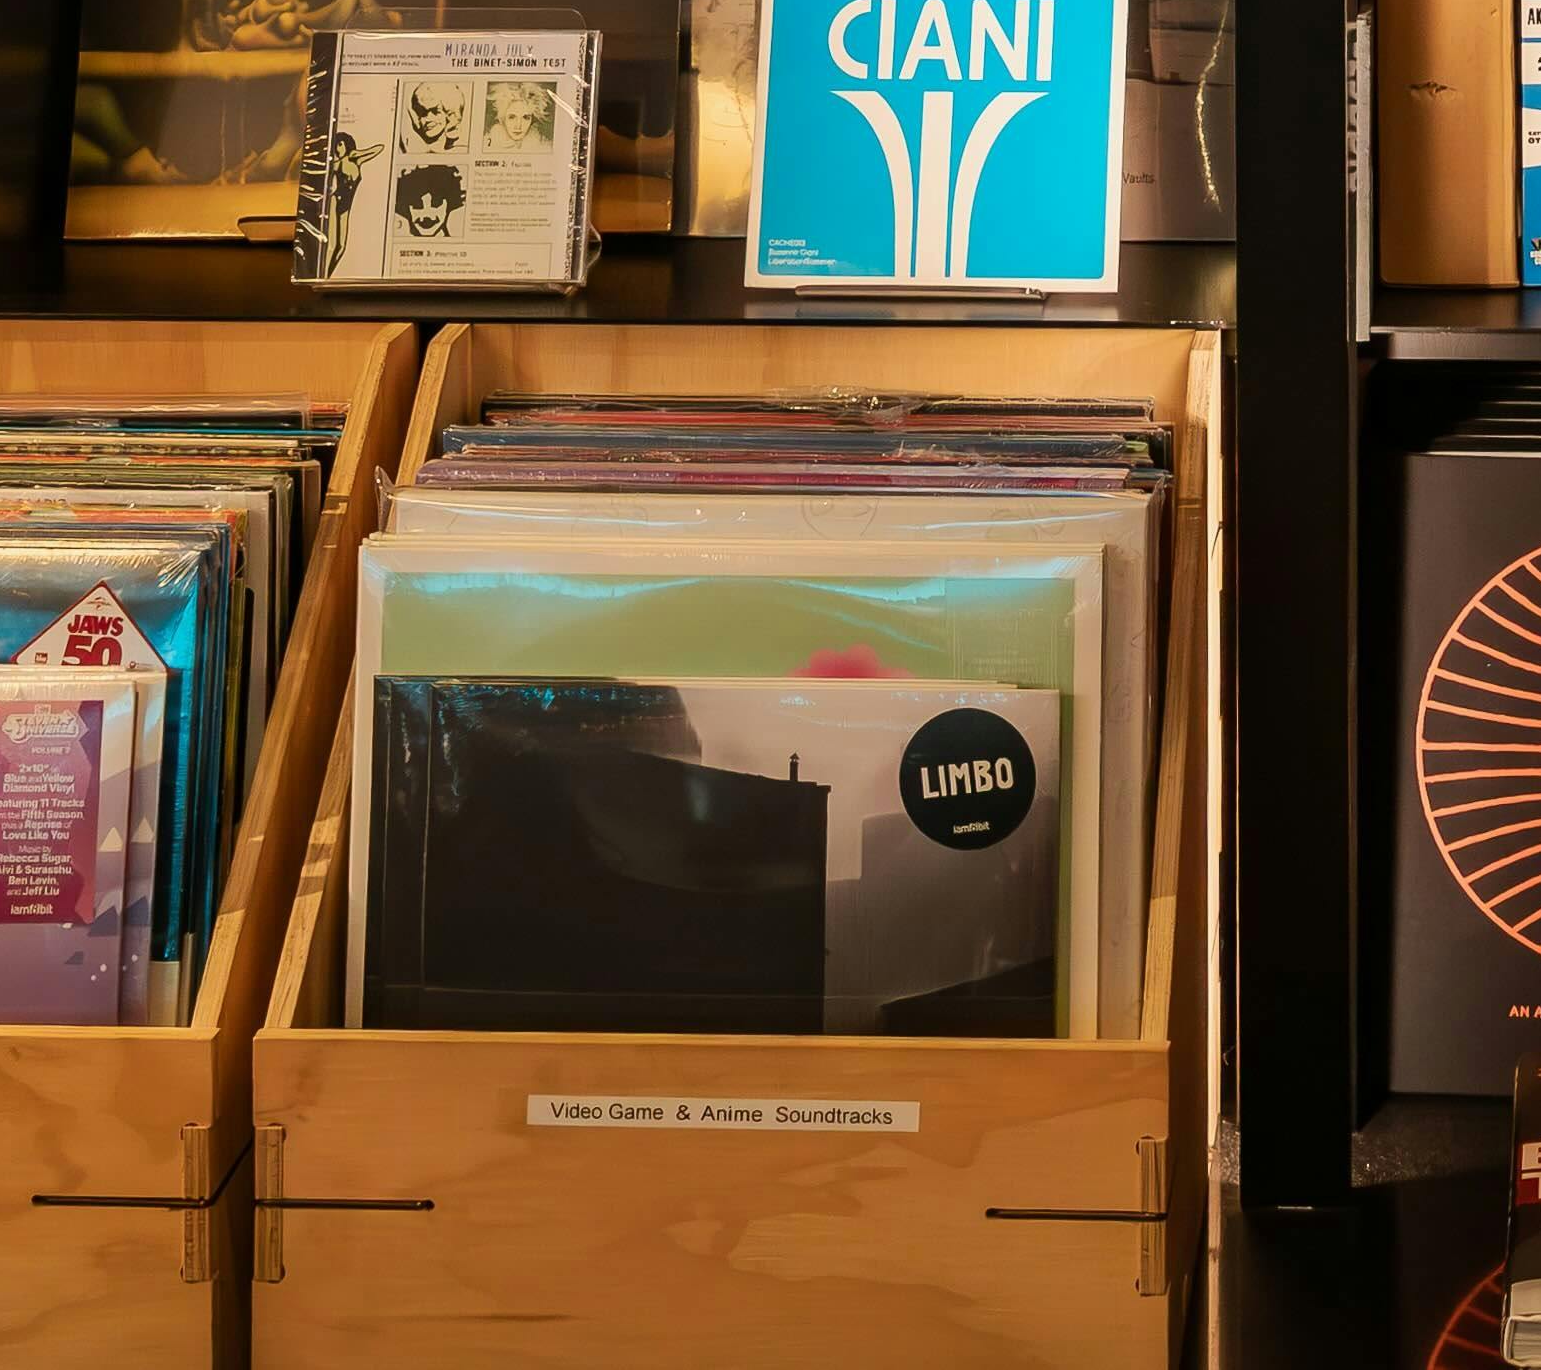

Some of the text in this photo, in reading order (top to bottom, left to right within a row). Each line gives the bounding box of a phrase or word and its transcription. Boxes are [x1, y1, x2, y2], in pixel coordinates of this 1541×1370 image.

[921, 758, 1015, 800] LIMBO
[550, 1102, 894, 1125] Video Game & Anime Soundtracks
